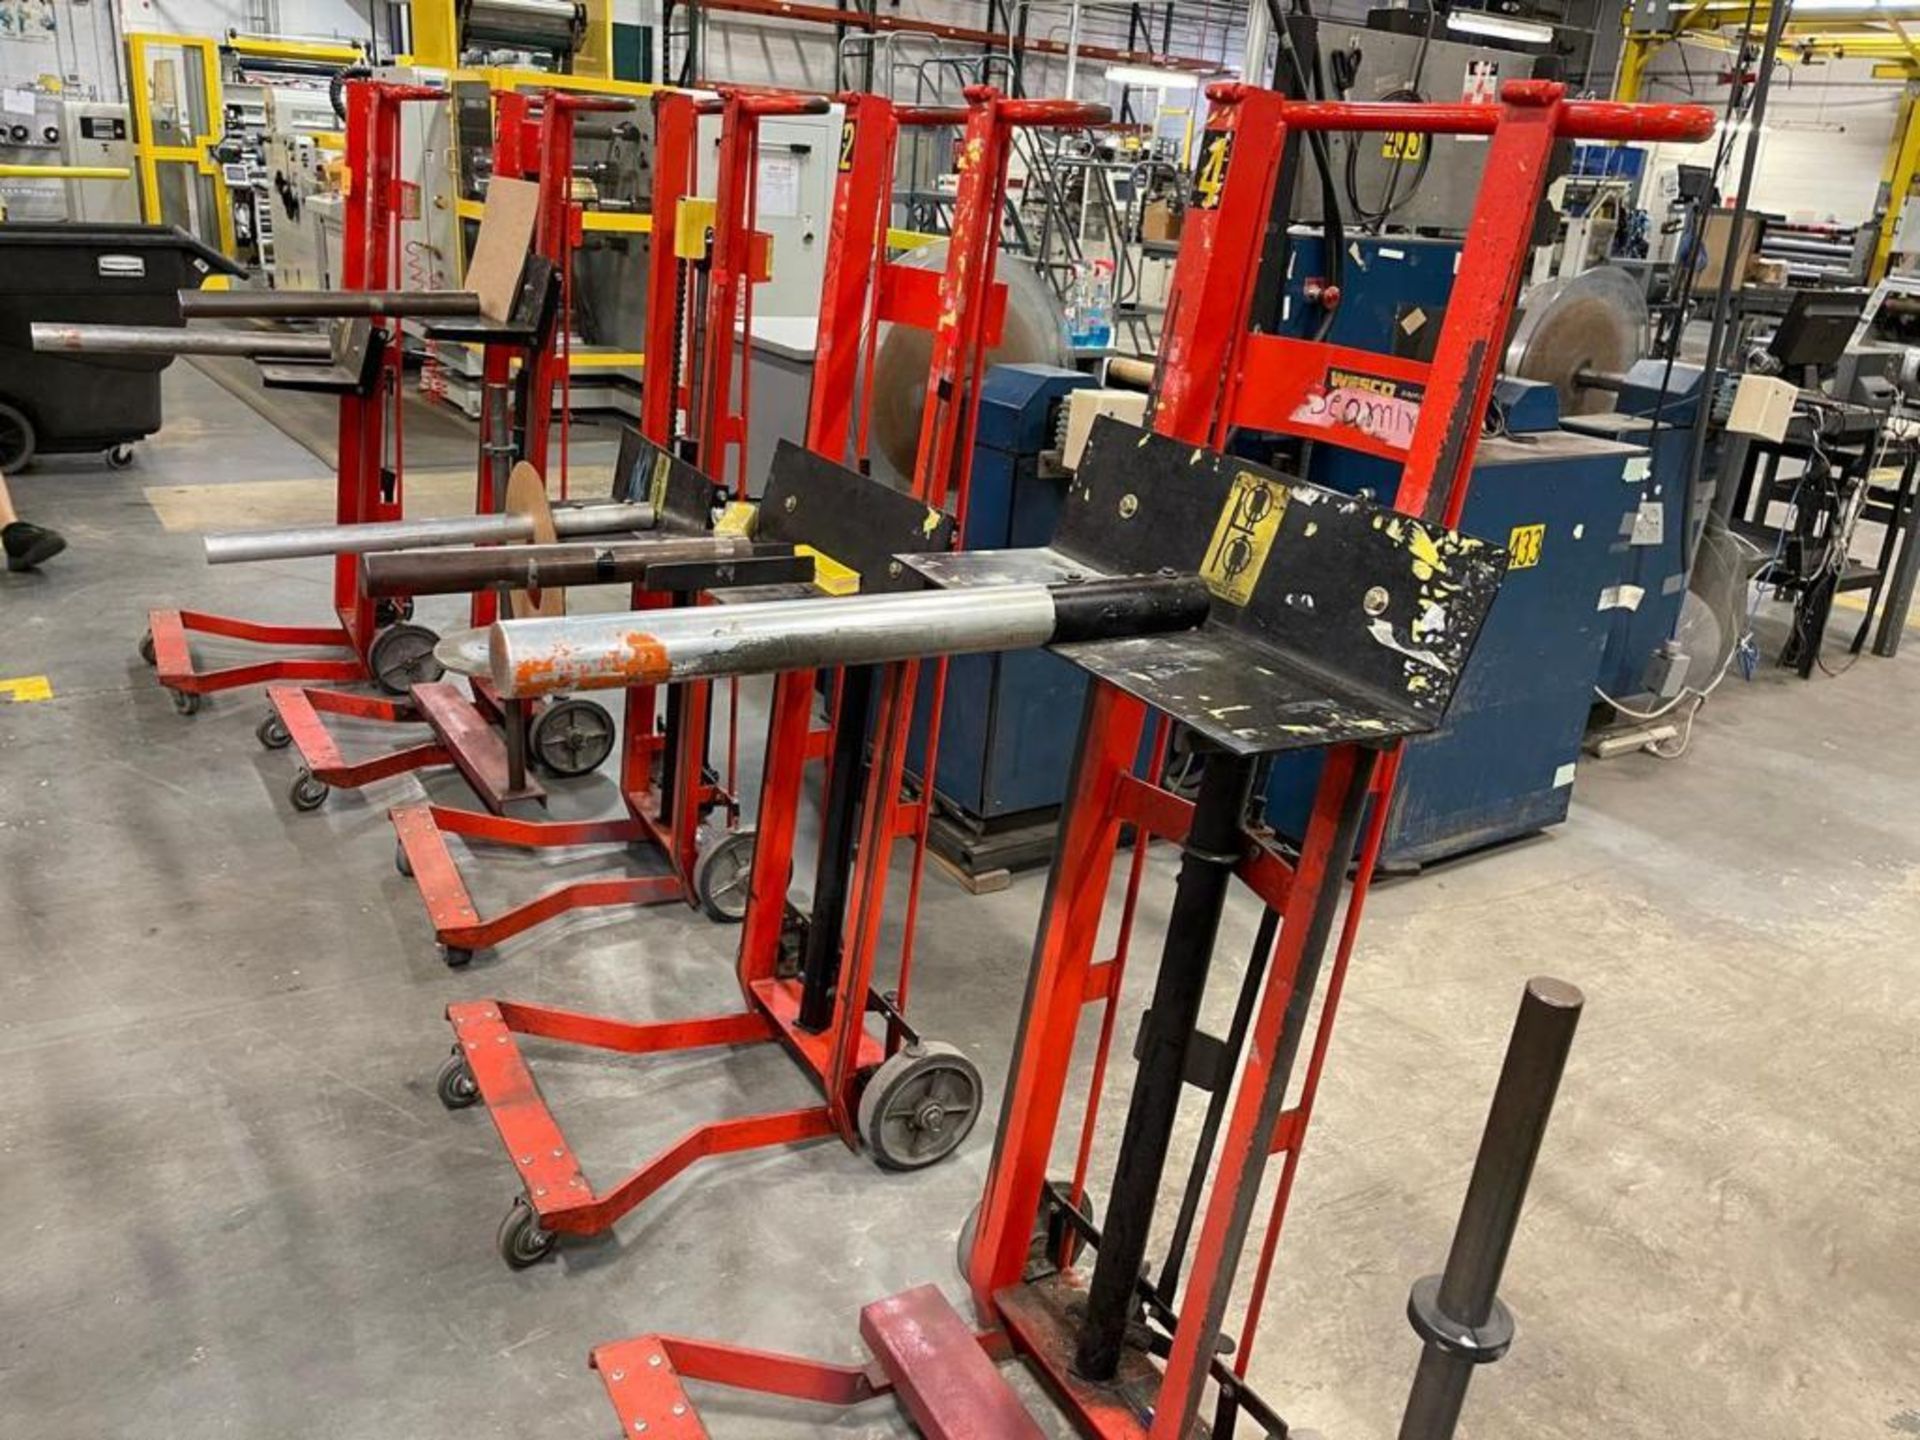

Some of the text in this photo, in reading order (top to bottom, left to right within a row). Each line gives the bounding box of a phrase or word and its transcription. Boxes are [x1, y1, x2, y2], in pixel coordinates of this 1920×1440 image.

[840, 122, 855, 170] 2
[1199, 136, 1228, 209] 4
[1330, 370, 1396, 397] WESCO
[1510, 529, 1542, 567] 433
